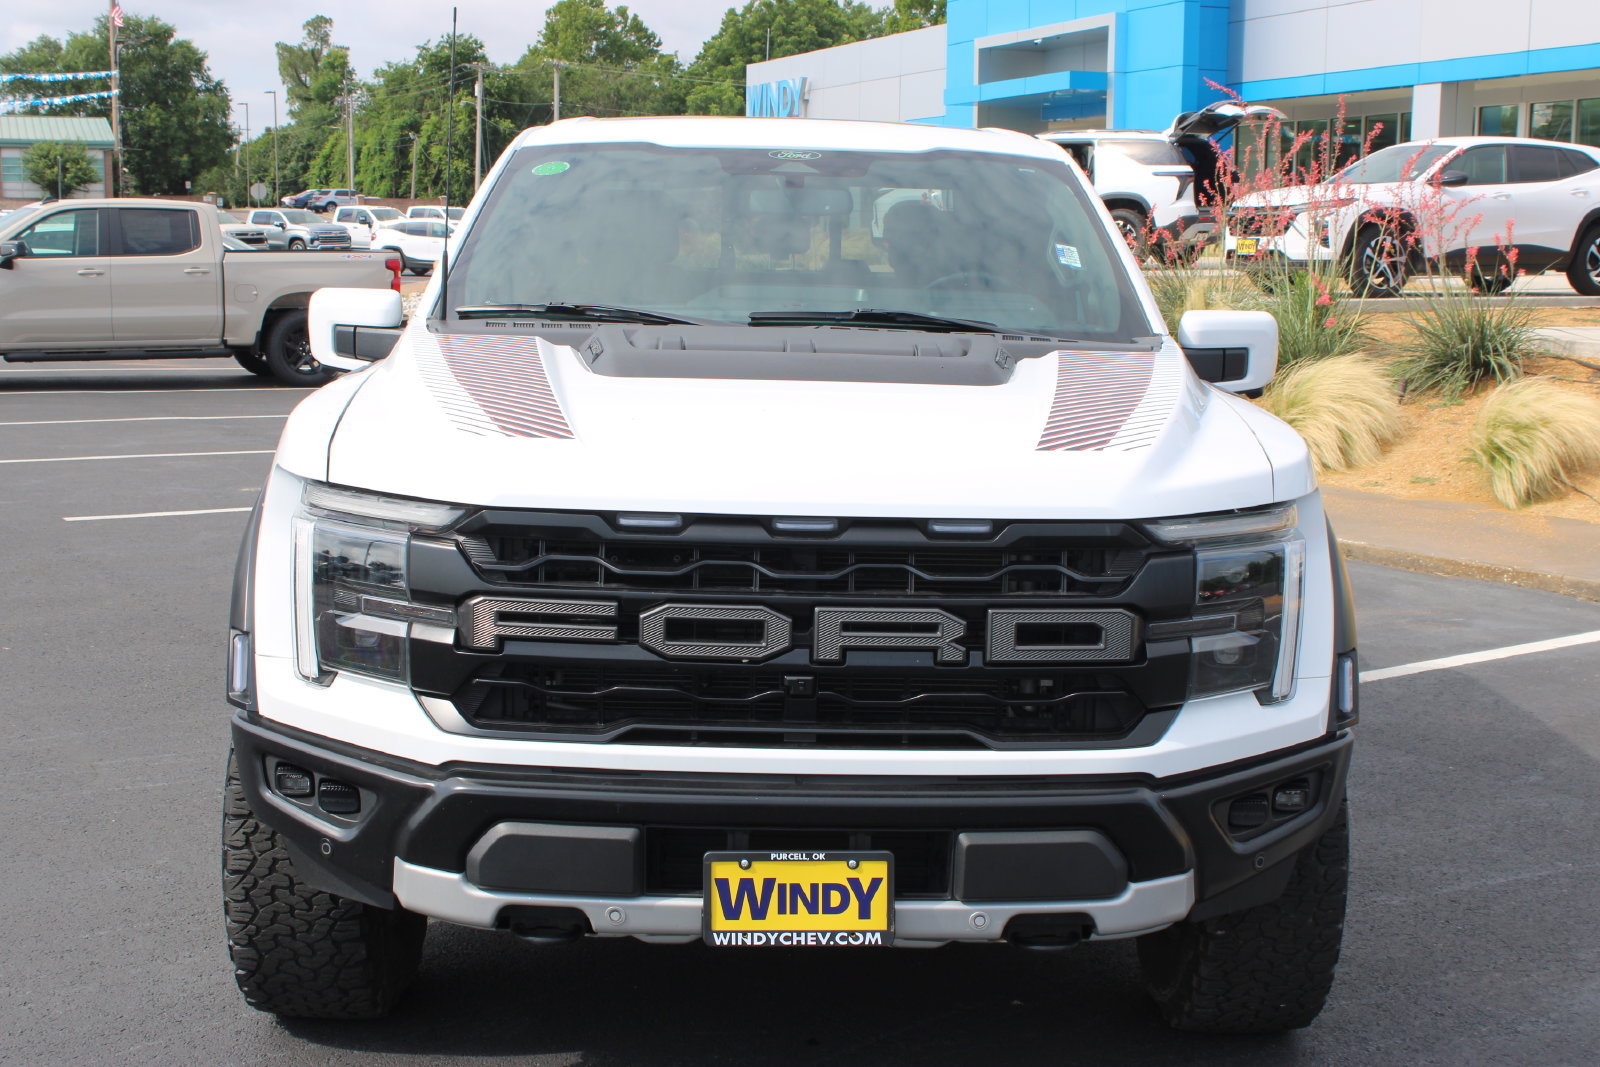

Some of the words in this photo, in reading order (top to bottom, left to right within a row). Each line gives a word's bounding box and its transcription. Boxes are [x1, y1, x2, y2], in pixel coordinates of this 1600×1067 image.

[746, 76, 808, 117] WINDY
[460, 597, 1142, 664] FORD
[770, 852, 810, 861] PURCELL,
[812, 852, 826, 861] OK
[714, 877, 884, 921] WINDY
[712, 932, 882, 945] WINDYCHEV.COM
